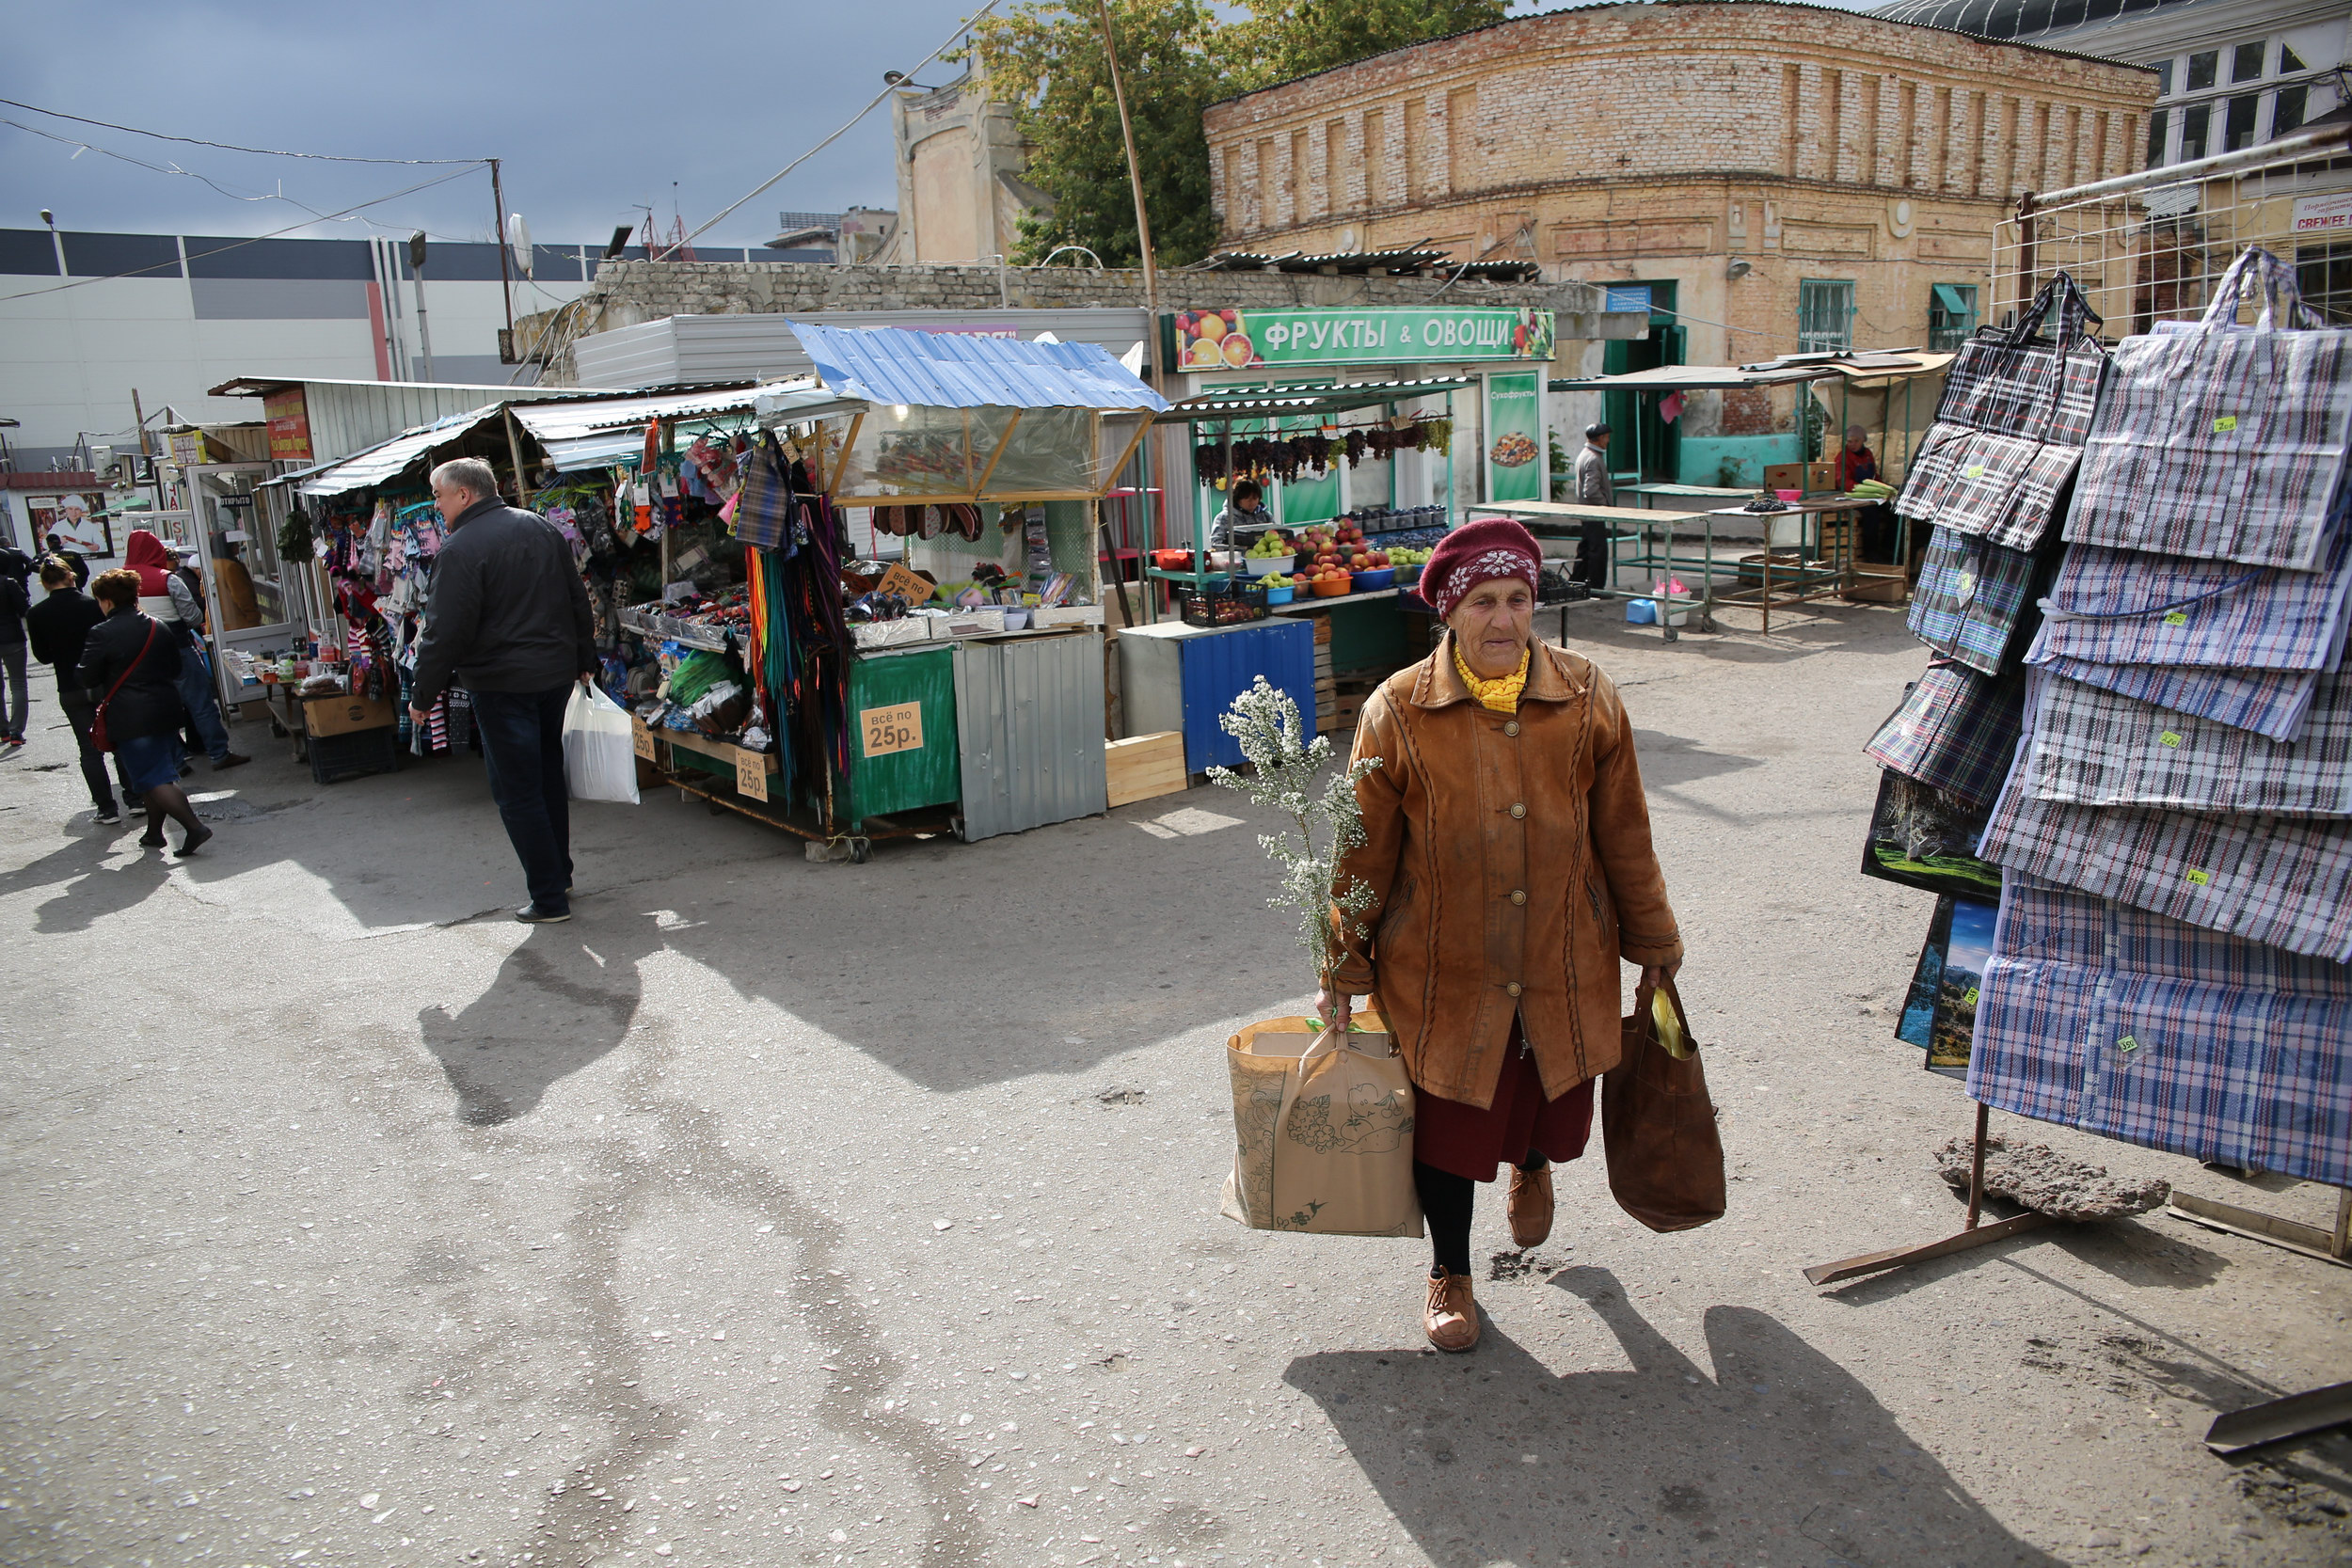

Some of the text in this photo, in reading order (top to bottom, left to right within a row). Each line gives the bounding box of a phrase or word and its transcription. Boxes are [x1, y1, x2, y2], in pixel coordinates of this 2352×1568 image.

[1264, 318, 1510, 351] ФРУКТЫ & ОВОЩИ
[1490, 388, 1536, 402] Сухофрукты
[893, 572, 925, 594] всё по
[871, 710, 912, 725] всё по
[634, 733, 654, 756] 25р.
[869, 725, 916, 749] 25р.
[740, 755, 761, 771] всё по
[740, 768, 764, 795] 25р.
